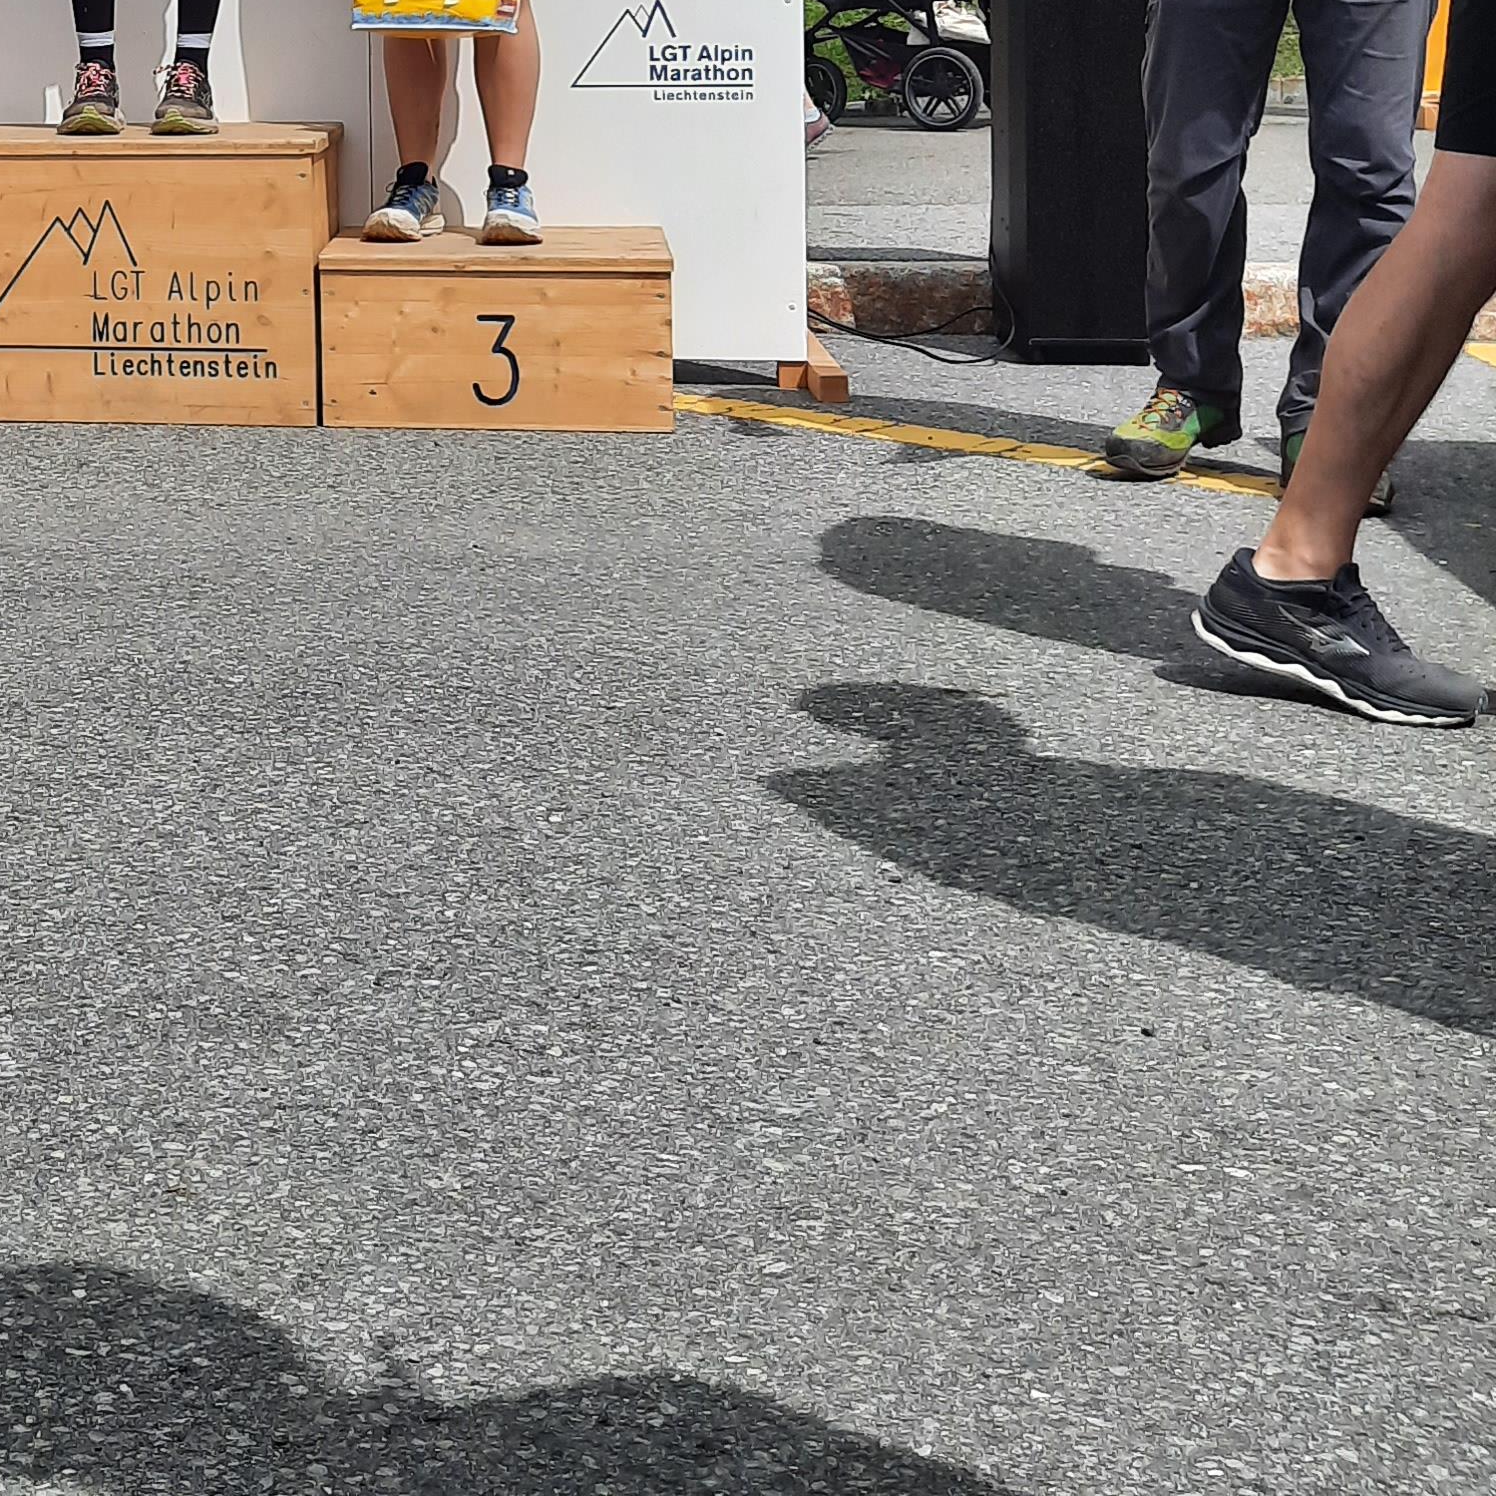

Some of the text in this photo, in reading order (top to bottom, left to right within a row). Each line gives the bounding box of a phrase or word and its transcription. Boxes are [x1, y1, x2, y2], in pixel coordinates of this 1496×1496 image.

[648, 44, 753, 65] LGT Alpin
[649, 64, 753, 81] Marathon
[653, 89, 754, 101] Liechtenstein
[92, 270, 258, 310] LGT Alpin
[92, 311, 240, 344] Marathon
[93, 351, 278, 379] Liechtenstein
[472, 314, 520, 406] 3
